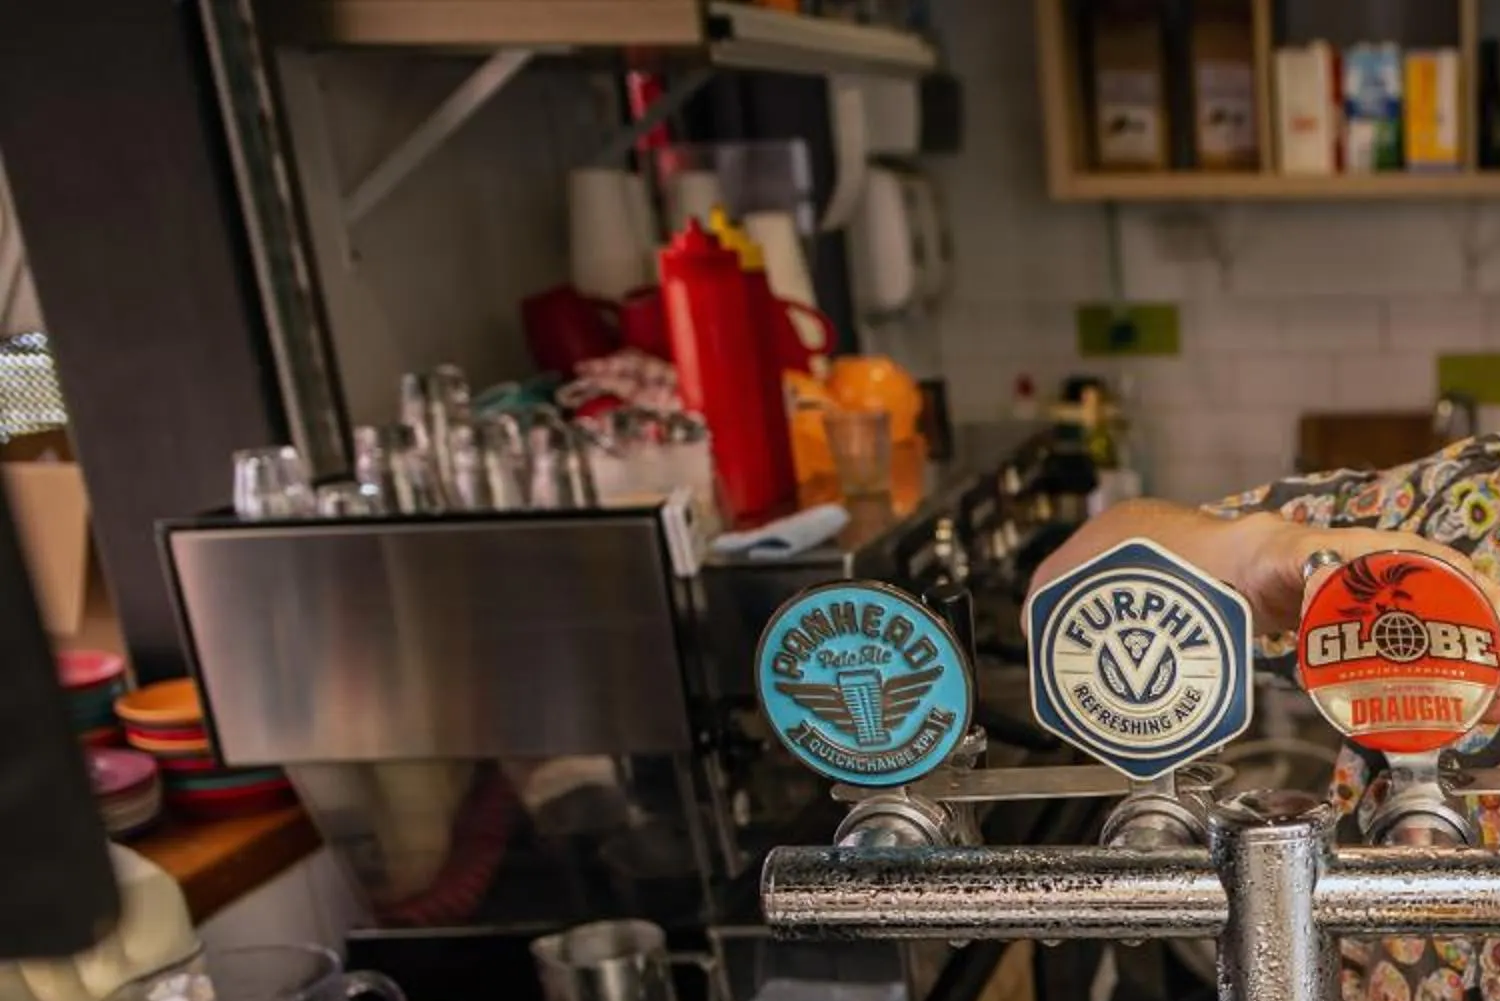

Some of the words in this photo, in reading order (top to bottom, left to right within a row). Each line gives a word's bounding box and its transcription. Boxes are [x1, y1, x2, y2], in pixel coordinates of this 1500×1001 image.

[772, 601, 939, 679] PANHEAD
[1064, 590, 1210, 650] FURPHY
[1306, 611, 1500, 668] GLOBE
[1074, 685, 1173, 735] REFRESHING
[1174, 687, 1202, 722] ALE
[1350, 695, 1465, 726] DRAUGHT
[809, 740, 913, 772] QUICKCHANGE
[912, 726, 940, 757] XPA
